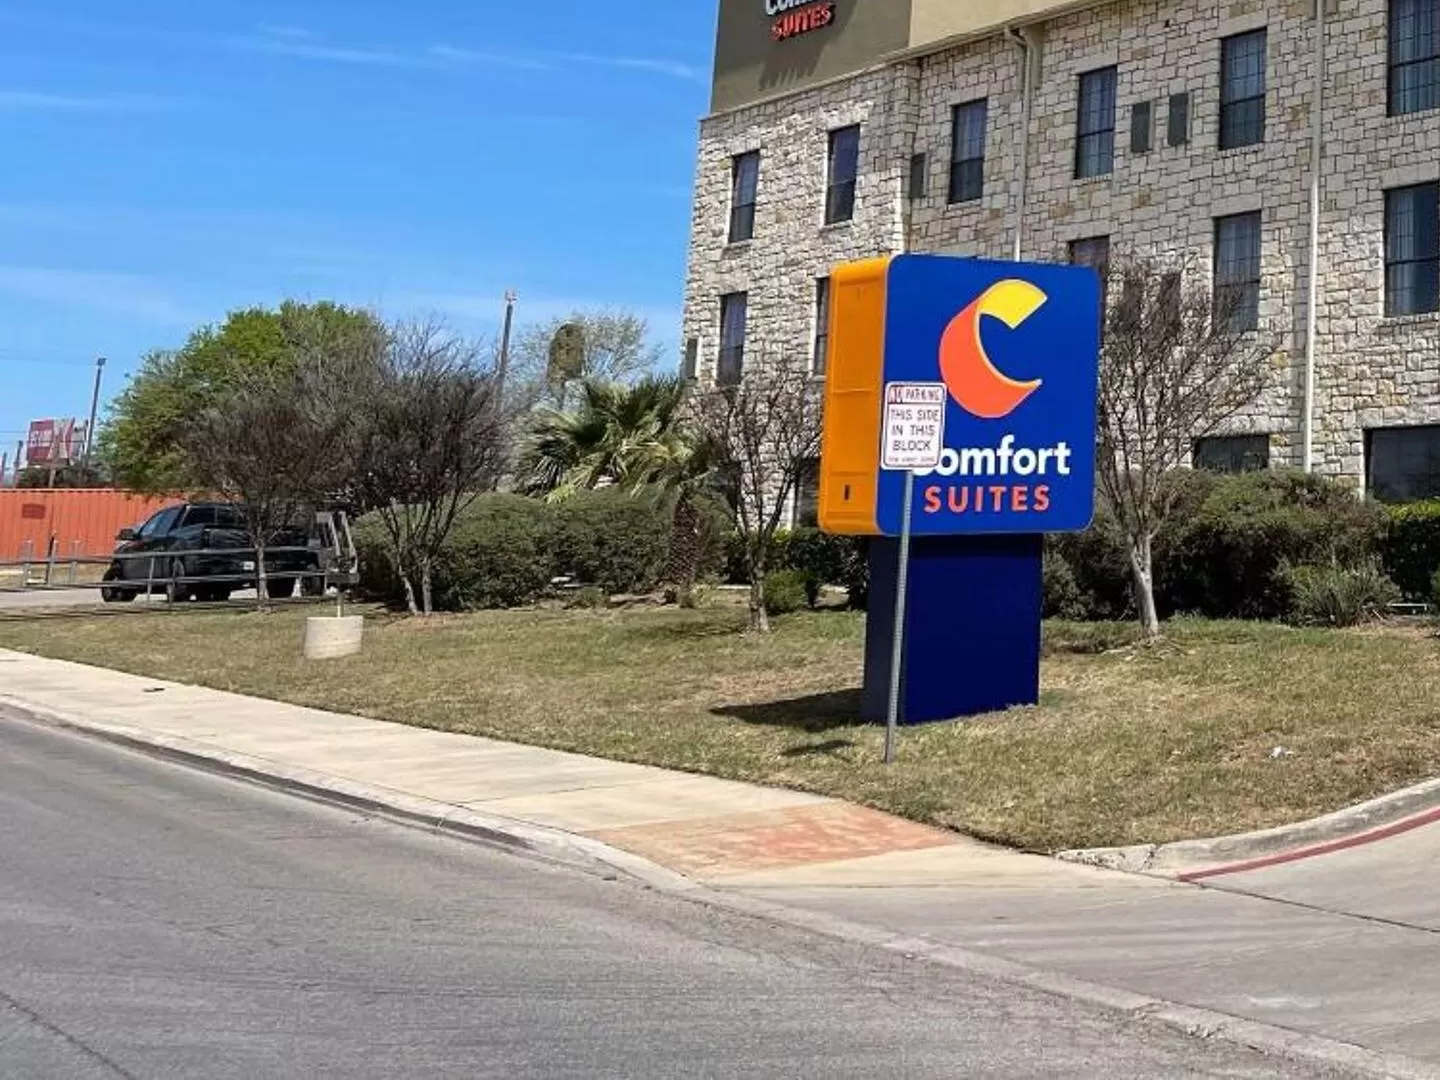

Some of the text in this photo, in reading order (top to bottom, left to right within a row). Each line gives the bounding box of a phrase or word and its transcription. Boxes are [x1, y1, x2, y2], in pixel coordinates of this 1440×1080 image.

[770, 2, 834, 41] SUITES
[890, 409, 939, 421] THIS SIDE
[891, 424, 935, 436] IN THIS
[893, 440, 931, 452] BLOCK
[913, 434, 1071, 476] omfort
[924, 485, 1050, 513] SUITES
